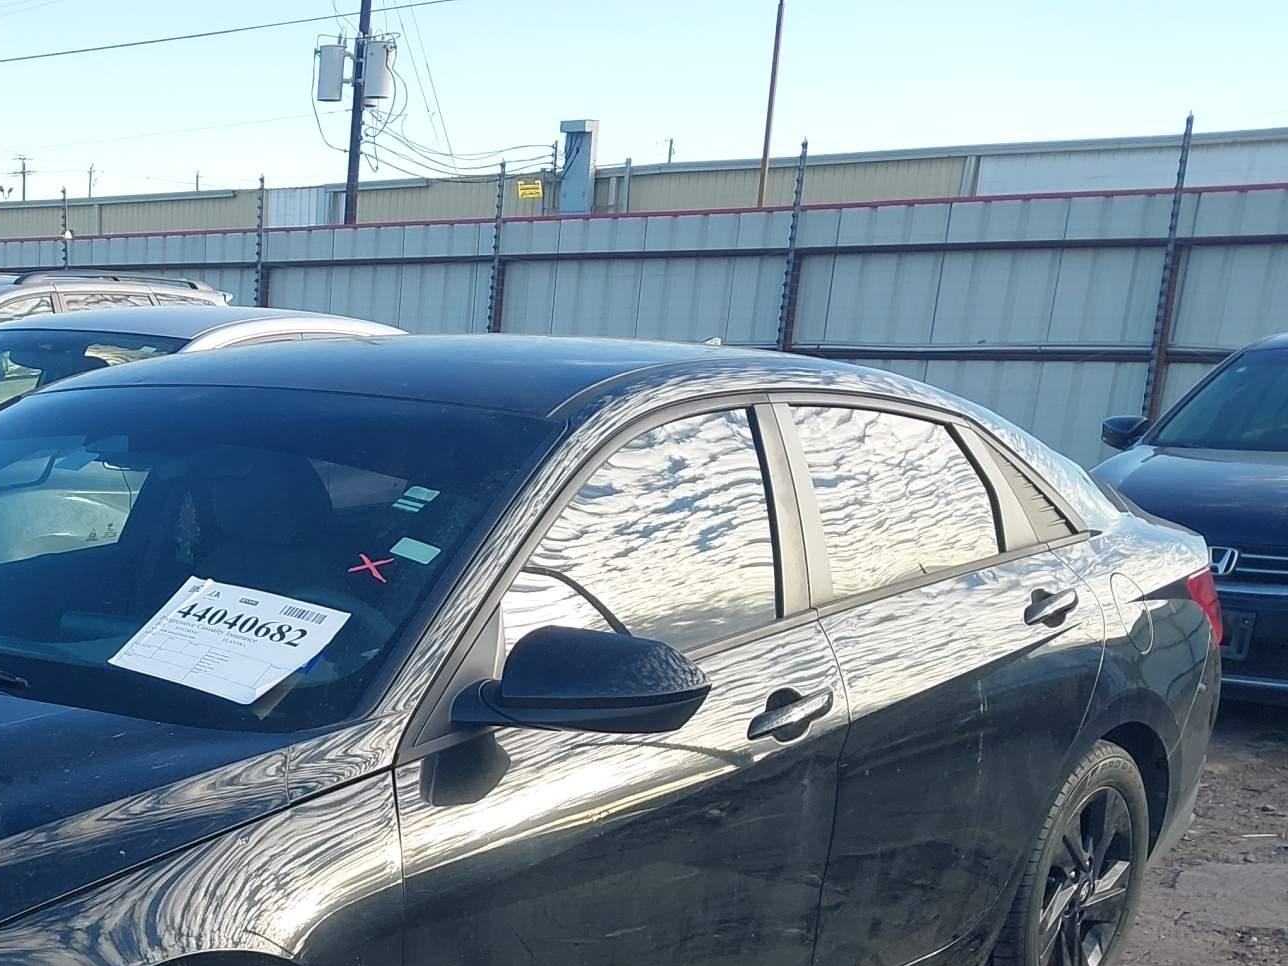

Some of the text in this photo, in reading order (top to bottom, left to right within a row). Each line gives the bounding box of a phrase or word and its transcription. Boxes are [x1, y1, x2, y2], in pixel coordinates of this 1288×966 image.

[176, 601, 309, 648] 44040682
[197, 623, 224, 636] Casualty
[224, 630, 259, 644] Insurance
